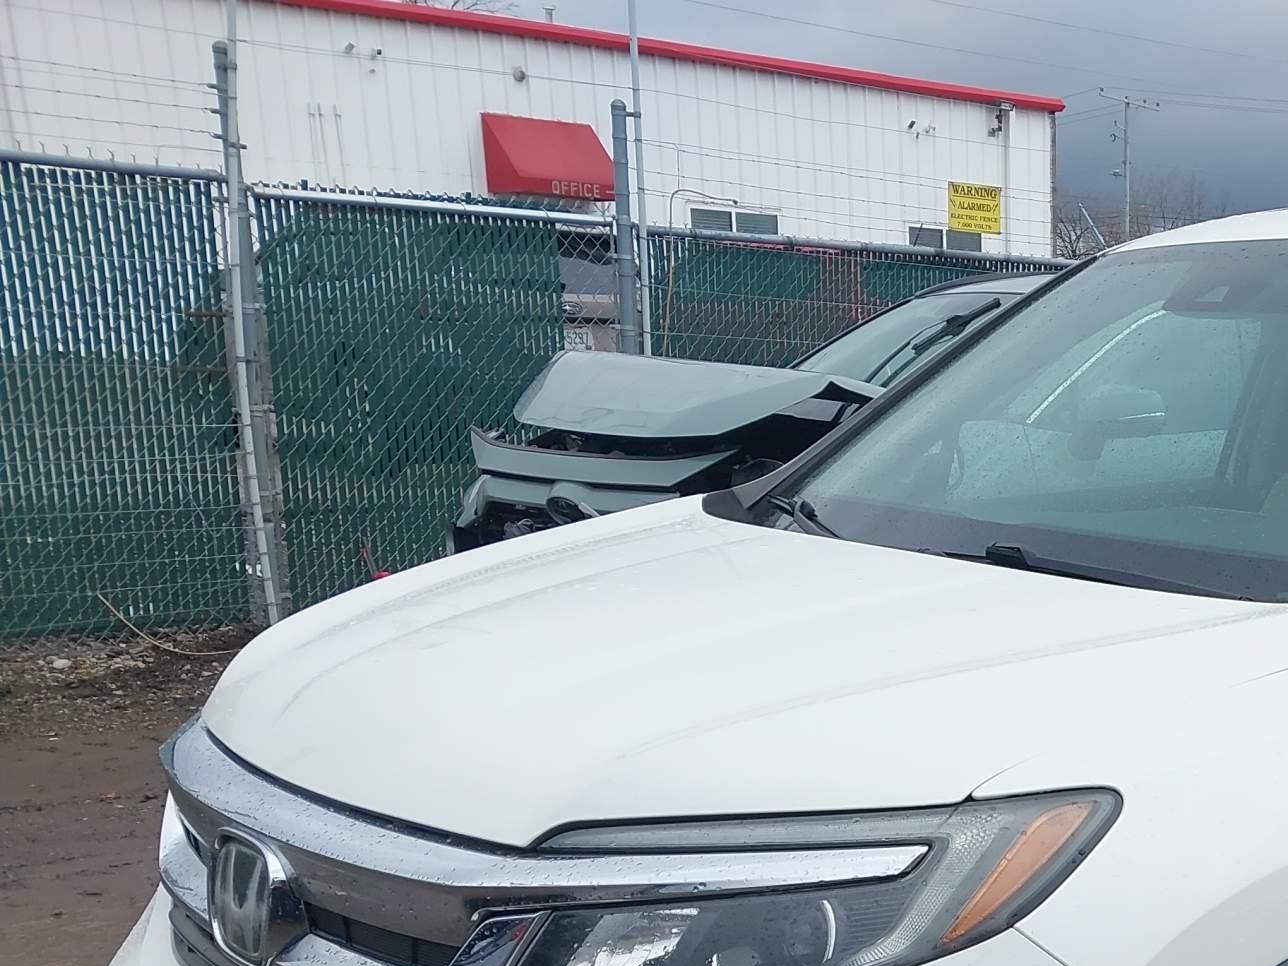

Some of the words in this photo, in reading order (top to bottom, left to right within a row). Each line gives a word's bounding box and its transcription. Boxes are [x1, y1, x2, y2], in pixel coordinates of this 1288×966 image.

[551, 180, 601, 198] OFFICE
[952, 184, 998, 199] WARNING
[957, 201, 992, 212] ALARMED
[951, 213, 978, 221] ELECTRIC
